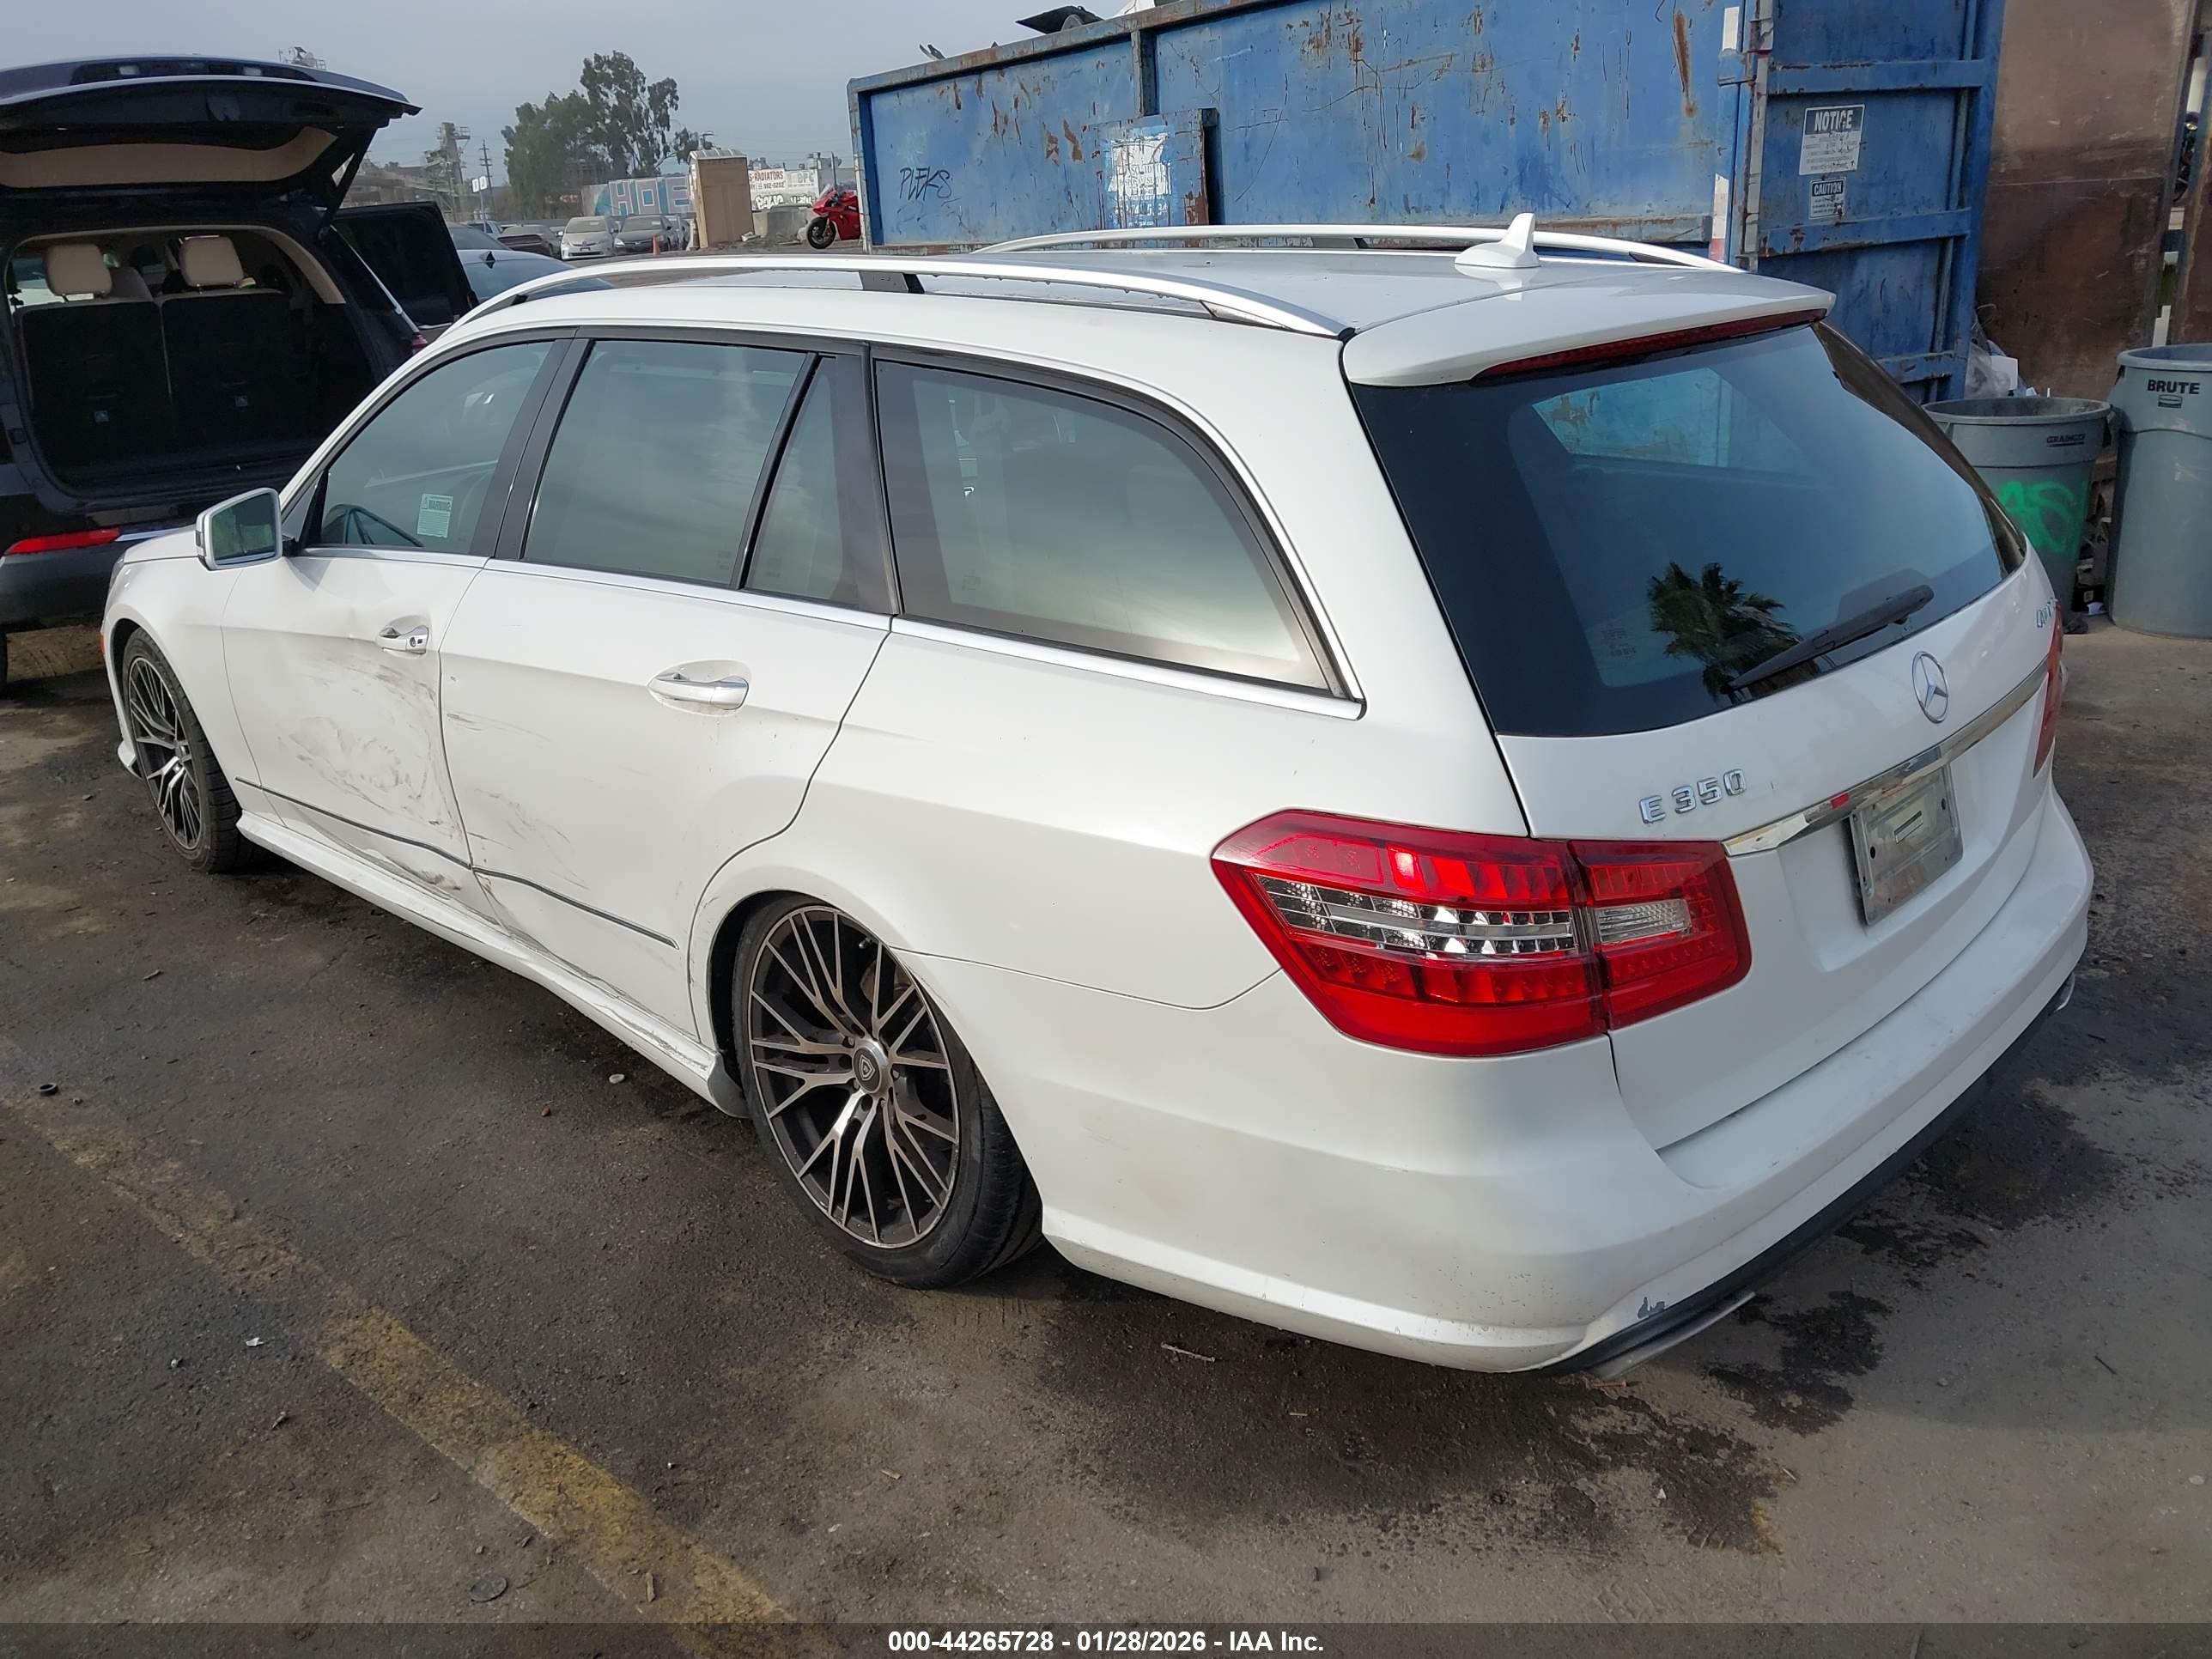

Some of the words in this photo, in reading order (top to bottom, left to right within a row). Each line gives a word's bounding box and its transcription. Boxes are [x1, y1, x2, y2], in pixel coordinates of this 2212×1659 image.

[1814, 110, 1854, 131] NOTICE
[1814, 181, 1842, 196] CAUTION
[2148, 379, 2201, 395] BRUTE
[1638, 794, 1667, 824] E
[1671, 769, 1746, 814] 350
